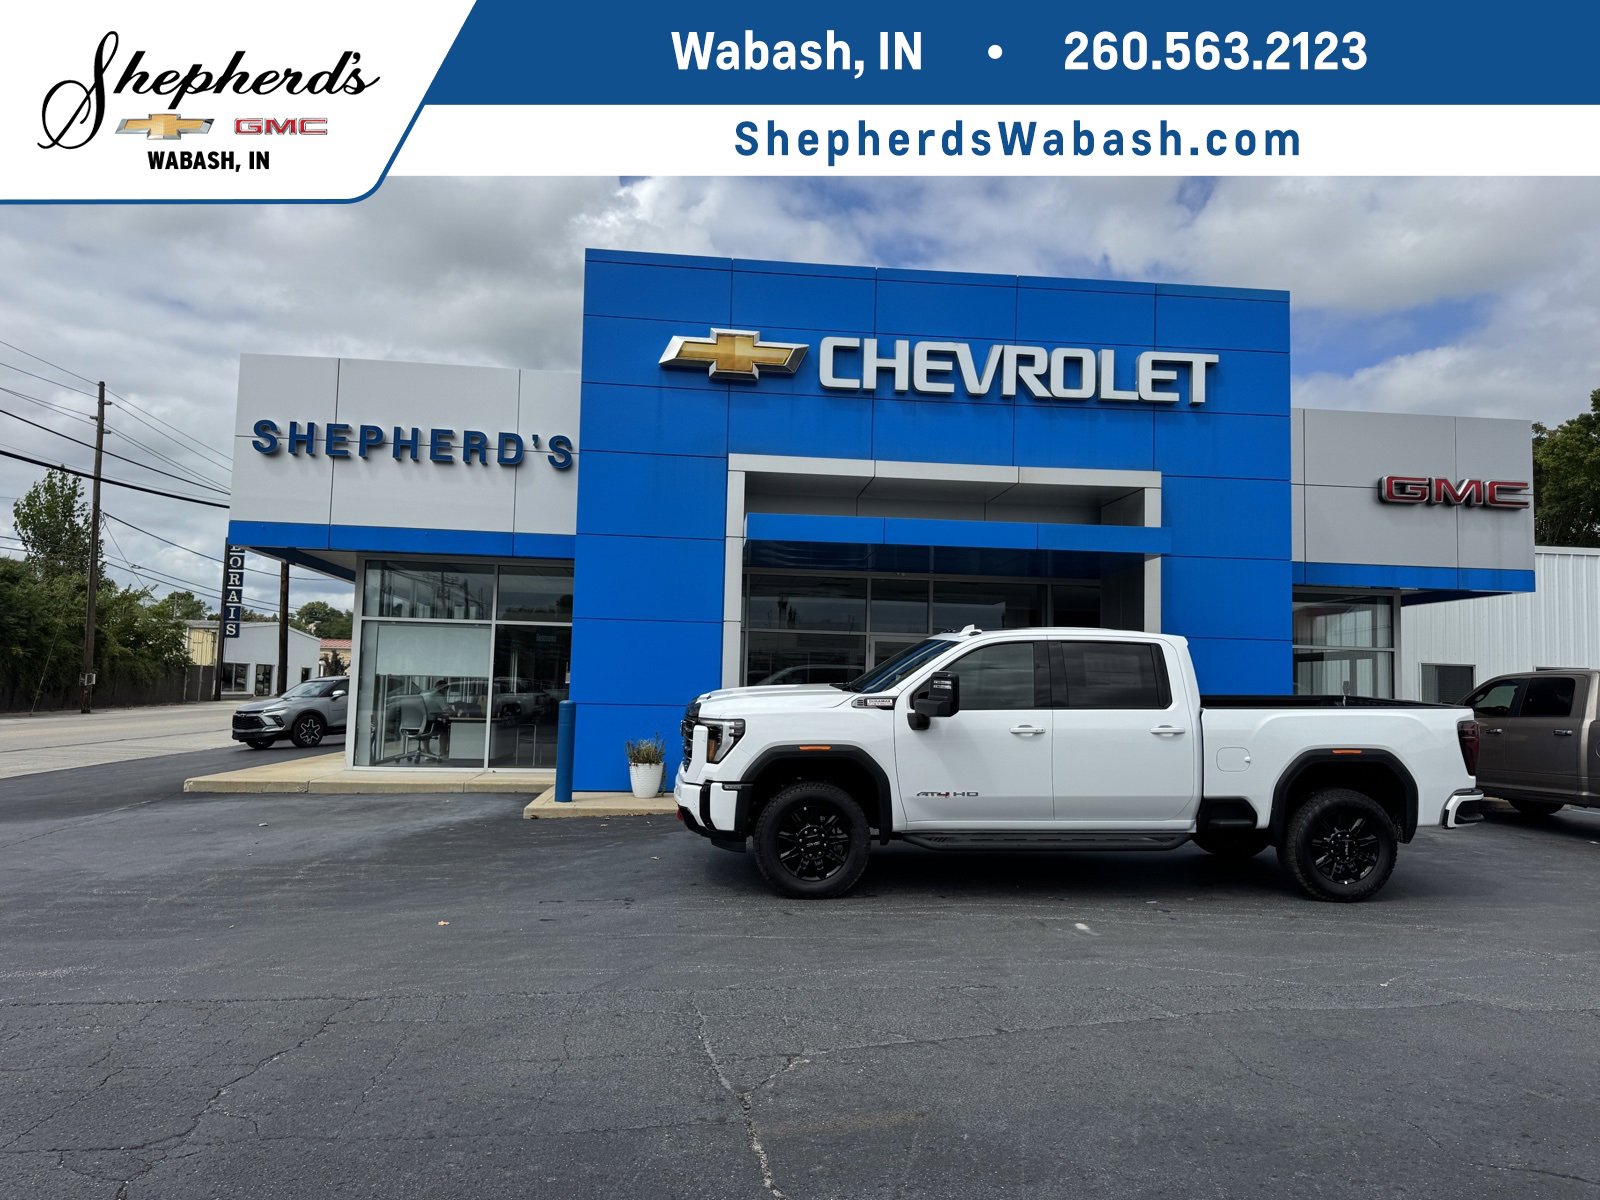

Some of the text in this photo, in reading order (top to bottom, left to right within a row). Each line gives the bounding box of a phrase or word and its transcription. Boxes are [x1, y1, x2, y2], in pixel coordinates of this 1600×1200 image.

[819, 336, 1220, 406] CHEVROLET
[252, 419, 574, 469] SHEPHERD'S
[1379, 475, 1530, 509] GMC
